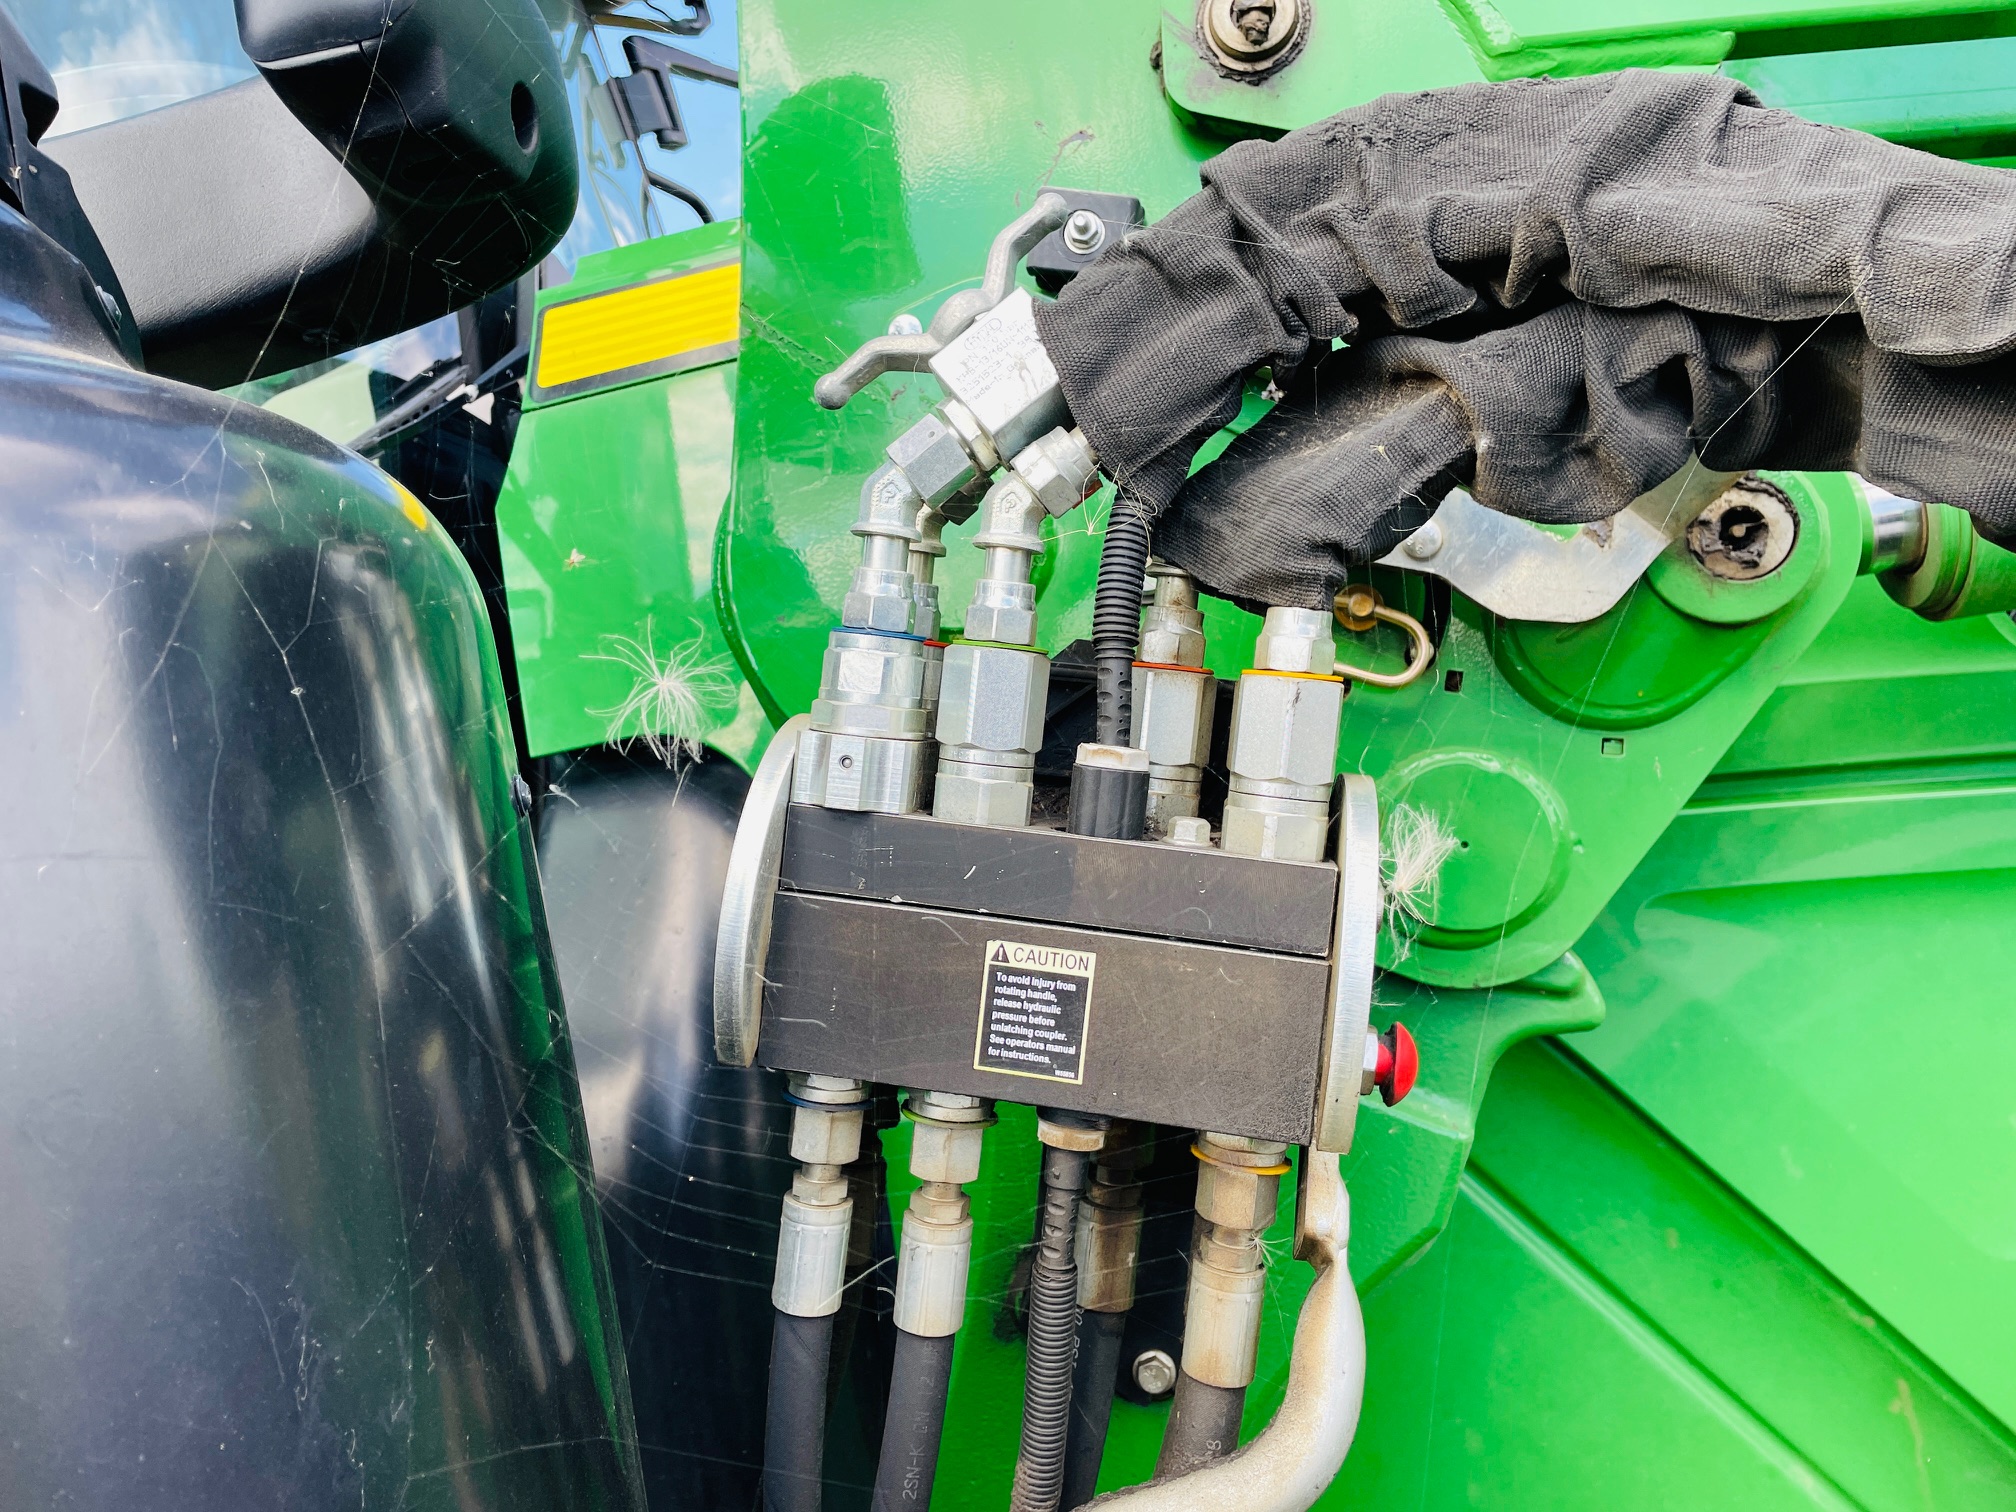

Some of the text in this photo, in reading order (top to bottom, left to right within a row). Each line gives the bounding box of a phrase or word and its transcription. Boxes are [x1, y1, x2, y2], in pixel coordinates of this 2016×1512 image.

[1013, 947, 1090, 972] CAUTION
[996, 971, 1076, 992] To avoid injury from
[994, 985, 1057, 1003] rotating handle,
[993, 997, 1061, 1015] release hydraulic
[991, 1010, 1055, 1027] pressure before
[990, 1022, 1068, 1042] unlatching coupler.
[989, 1033, 1076, 1055] See operators manual
[987, 1045, 1052, 1064] for instructions.
